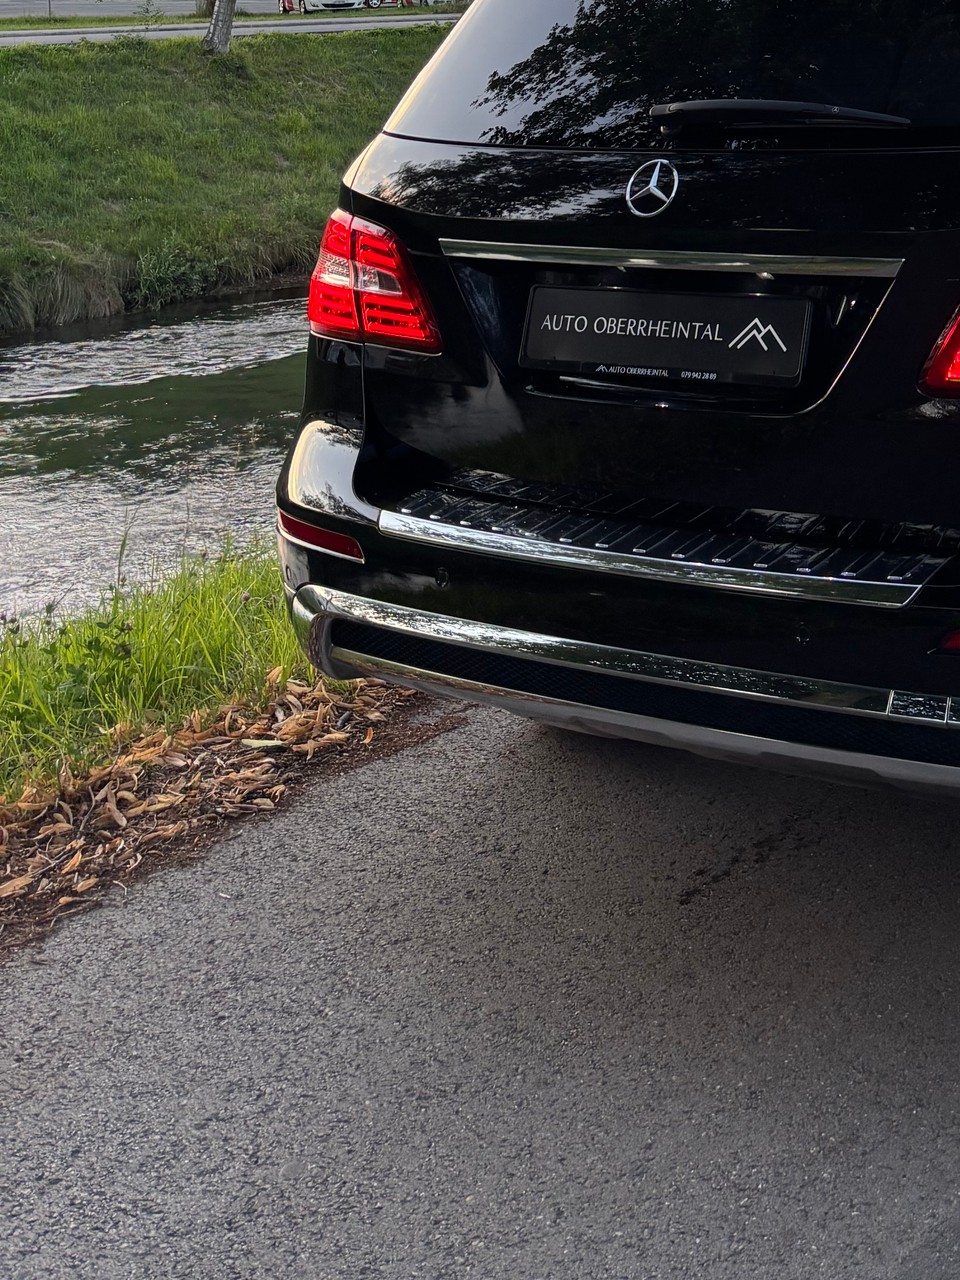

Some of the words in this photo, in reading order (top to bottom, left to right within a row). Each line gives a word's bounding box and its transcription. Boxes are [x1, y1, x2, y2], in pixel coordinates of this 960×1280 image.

[541, 314, 588, 333] AUTO
[593, 316, 723, 341] OBERRHEINTAL
[608, 366, 626, 374] AUTO
[626, 367, 669, 377] OBERRHEINTAL
